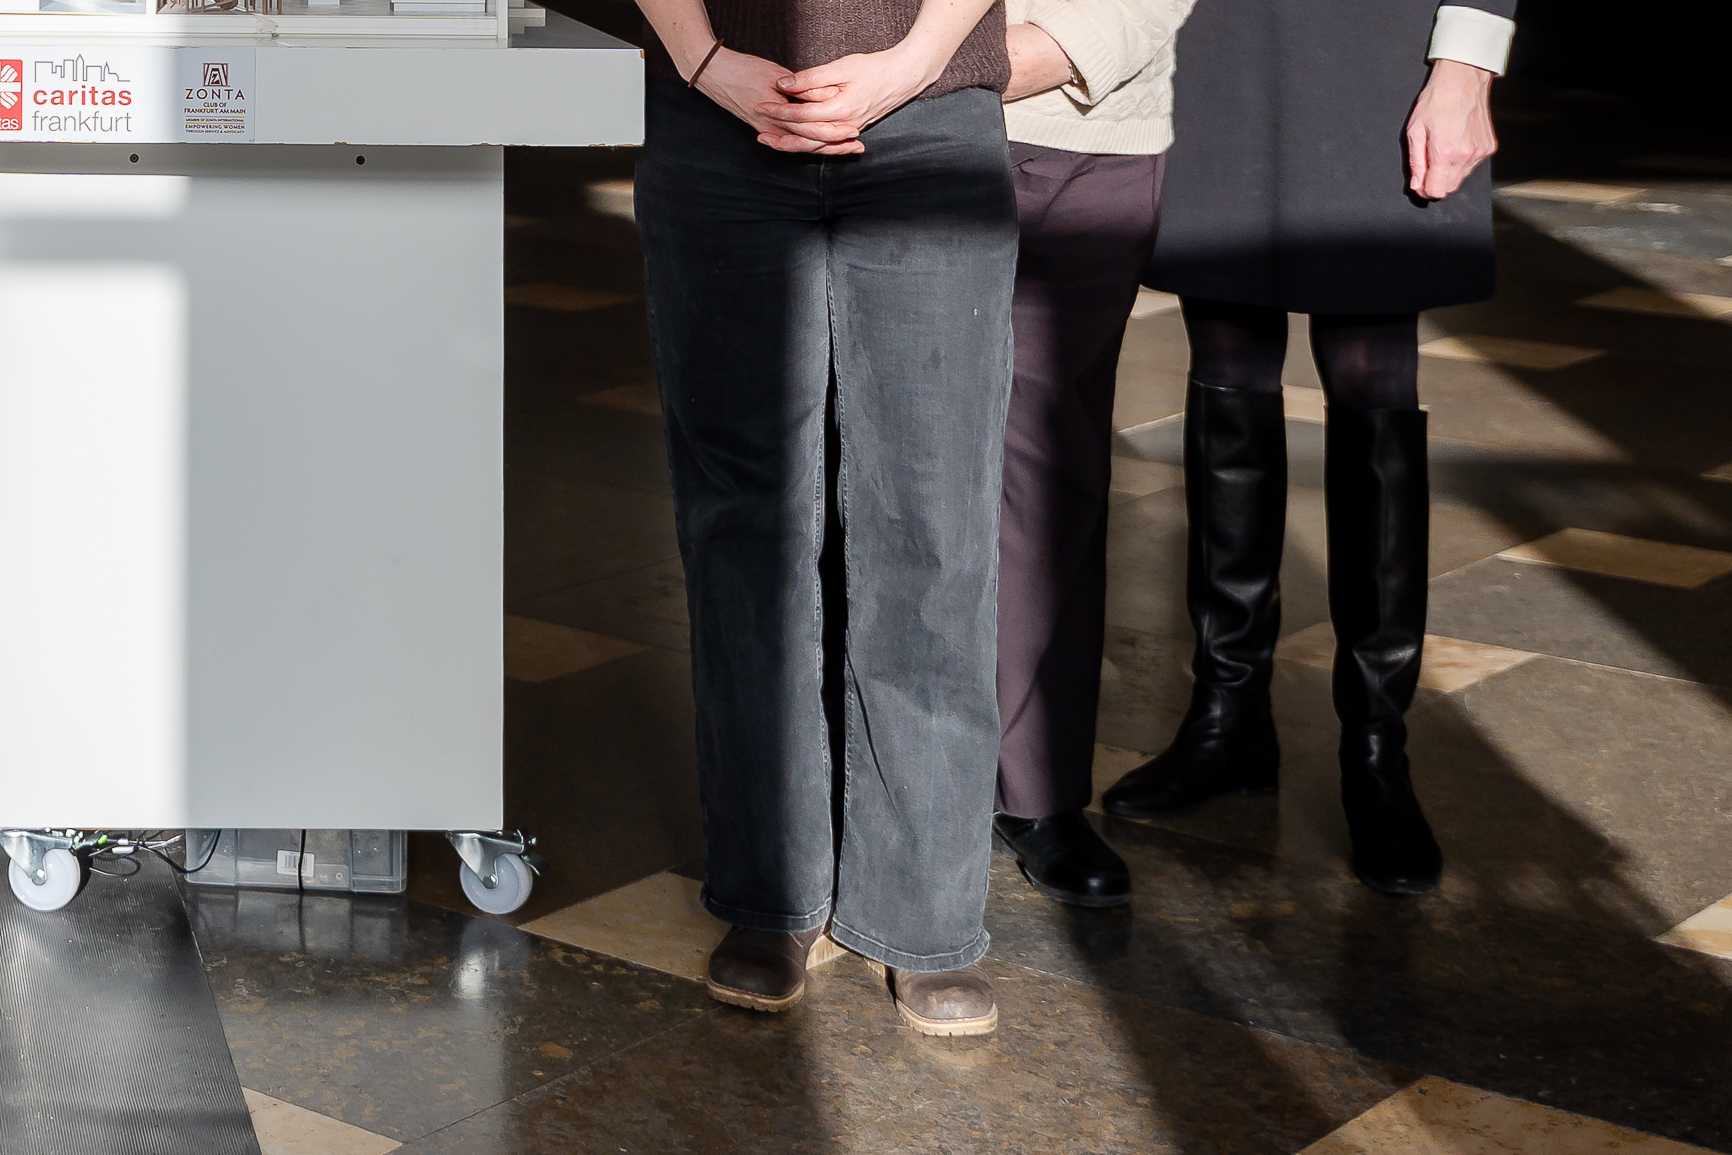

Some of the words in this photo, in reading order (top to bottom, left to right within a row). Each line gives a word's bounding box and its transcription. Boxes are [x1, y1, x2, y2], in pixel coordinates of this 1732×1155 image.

[33, 84, 132, 106] caritas
[185, 88, 245, 100] ZONTA
[32, 110, 132, 132] frankfurt
